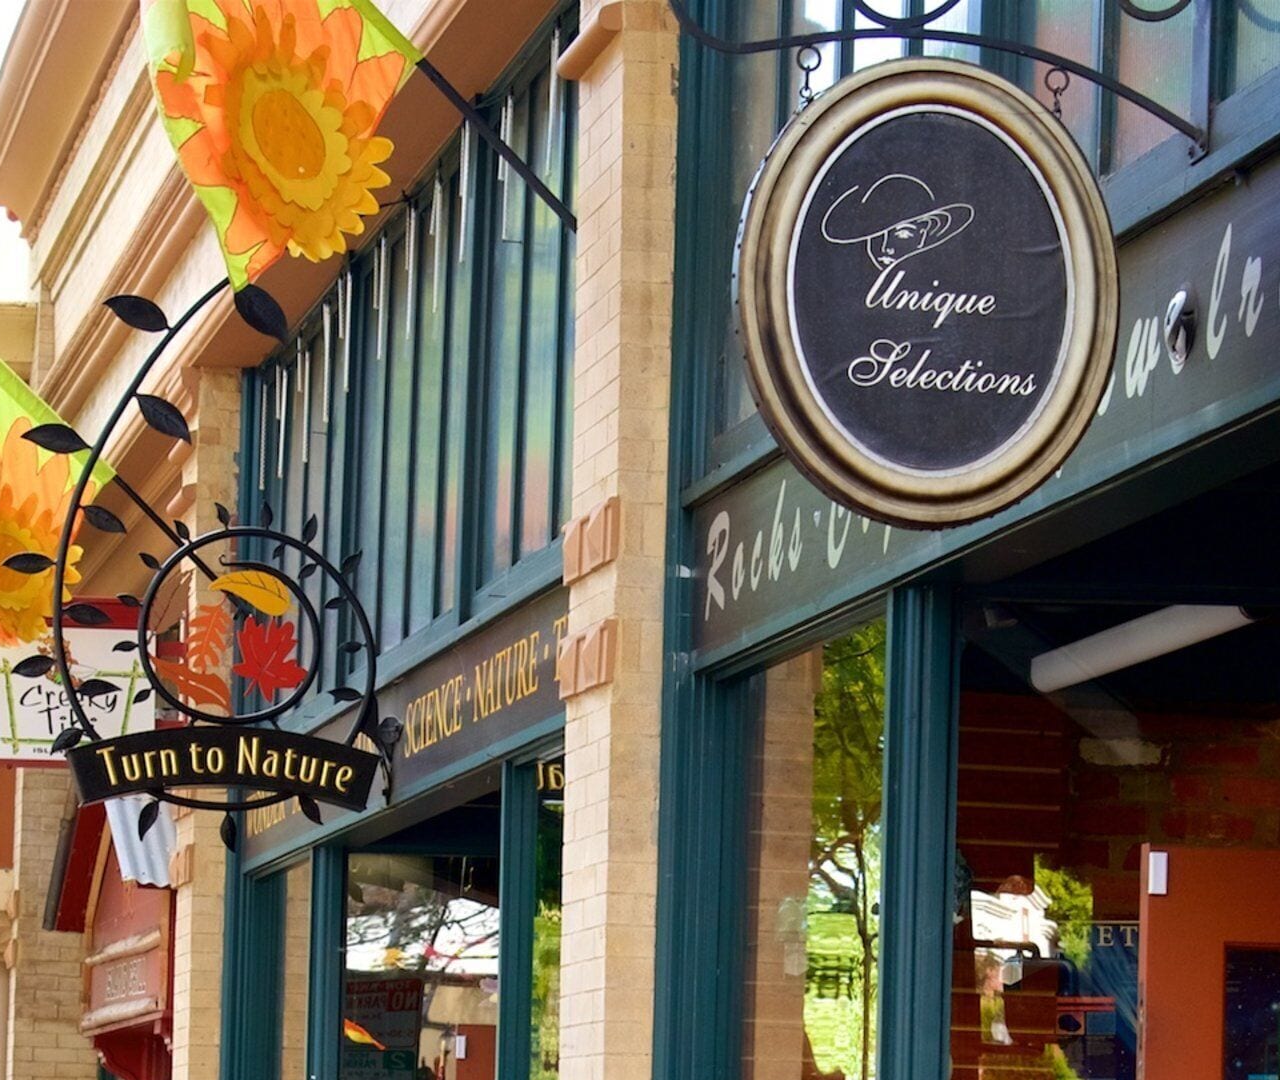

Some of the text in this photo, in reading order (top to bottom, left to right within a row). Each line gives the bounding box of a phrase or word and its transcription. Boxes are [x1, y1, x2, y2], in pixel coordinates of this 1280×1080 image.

[865, 268, 996, 328] Unique
[848, 339, 1037, 397] Selections
[705, 479, 803, 621] Rocks
[404, 674, 463, 758] SCIENCE
[473, 630, 540, 722] NATURE
[96, 745, 180, 787] Turn
[189, 742, 224, 774] to
[236, 735, 355, 793] Nature
